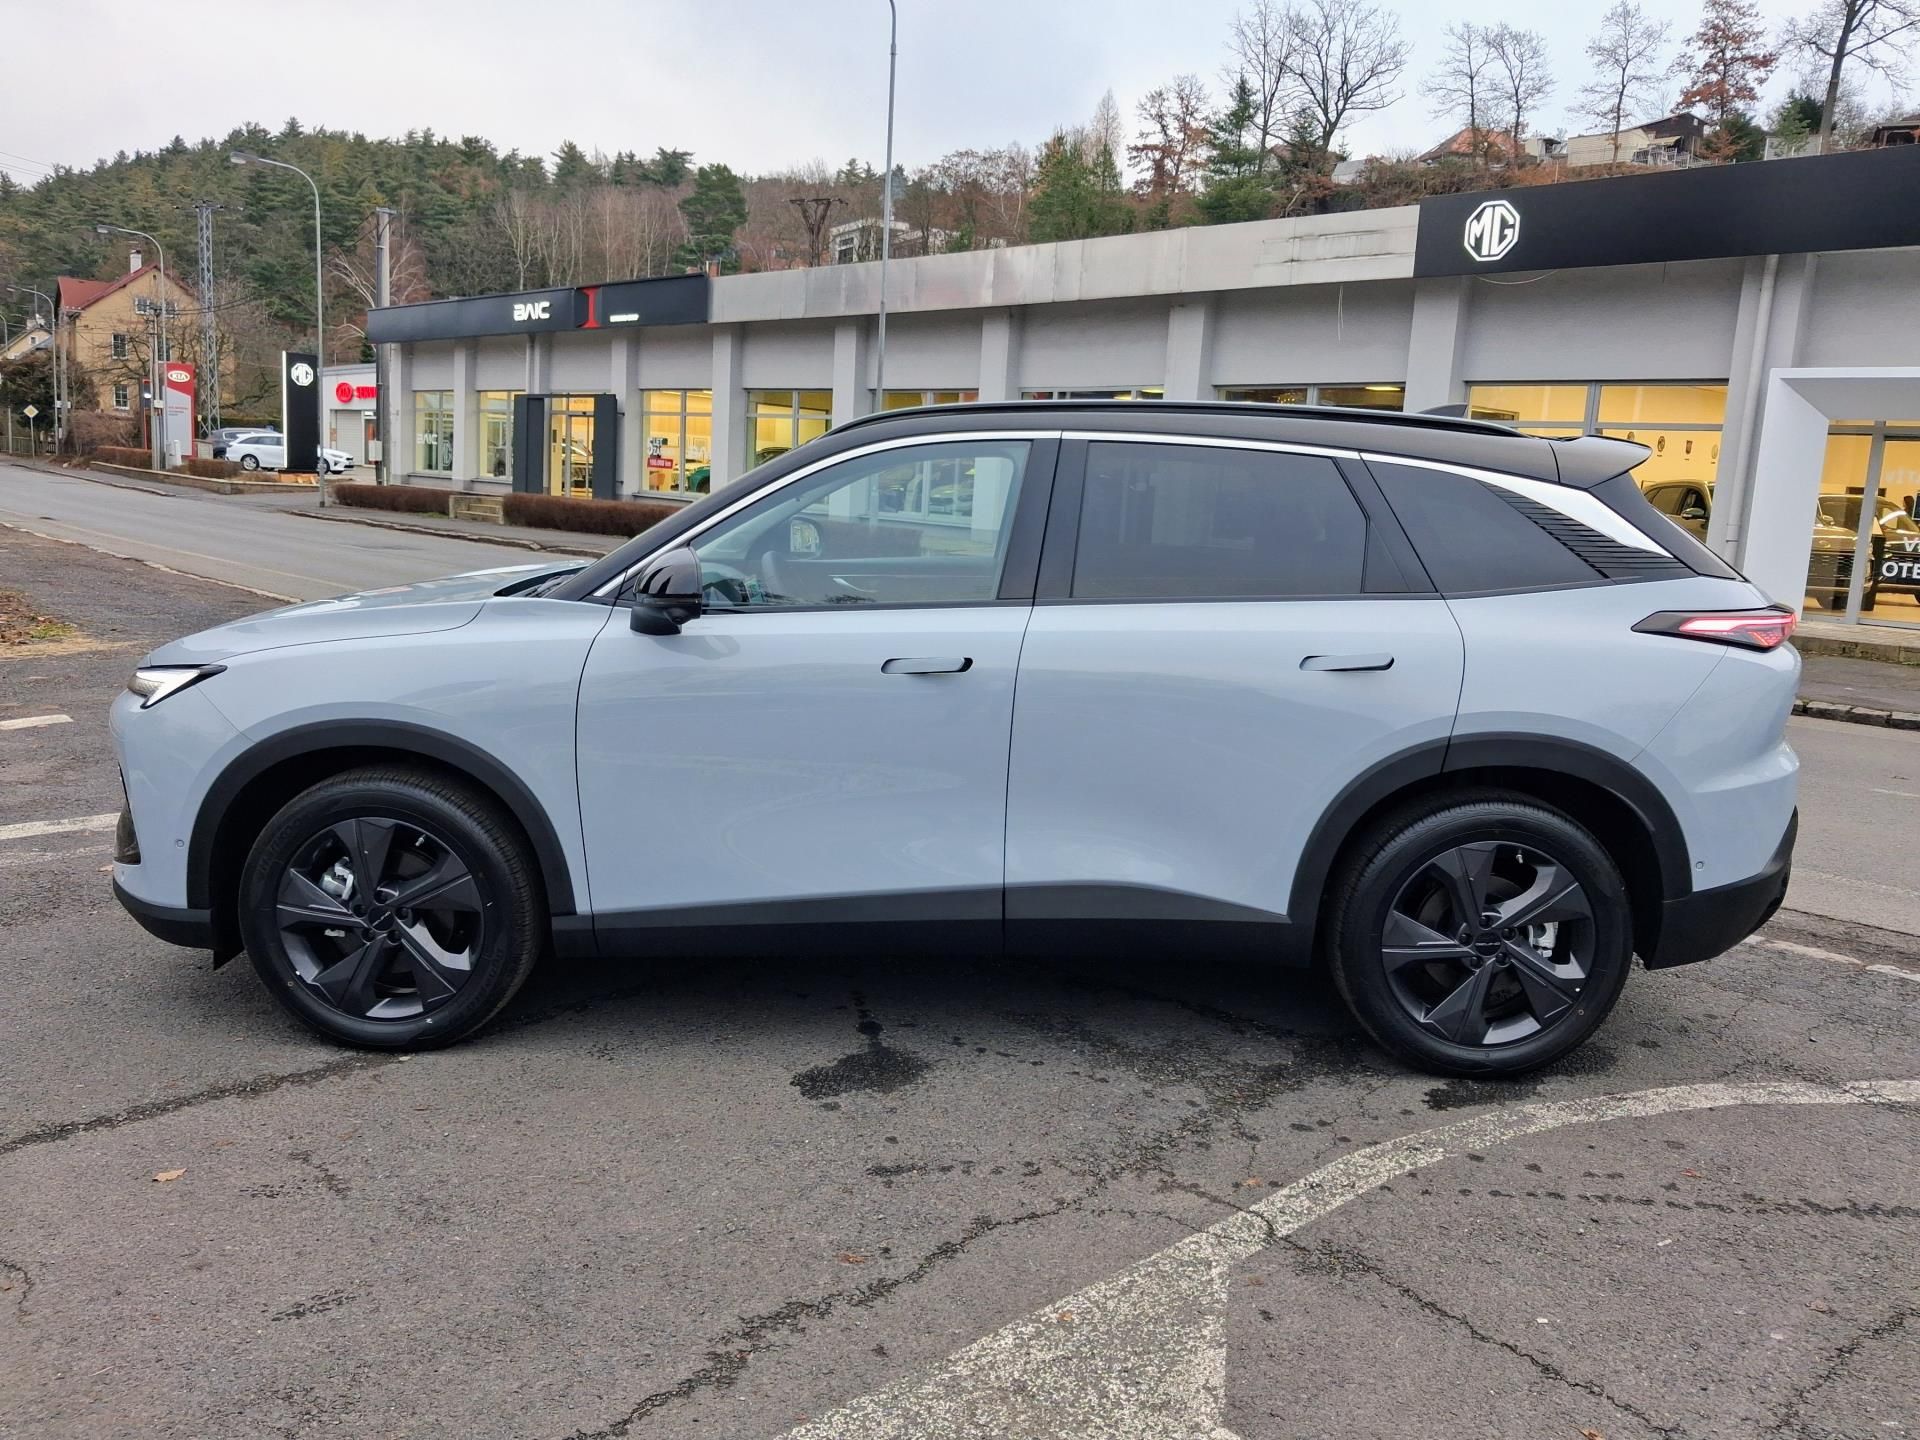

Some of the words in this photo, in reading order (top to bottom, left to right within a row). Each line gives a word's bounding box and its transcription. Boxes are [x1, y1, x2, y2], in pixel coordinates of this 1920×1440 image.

[1468, 204, 1516, 258] MG
[513, 301, 550, 321] BAIC
[169, 371, 189, 381] KIA
[291, 363, 314, 386] MG
